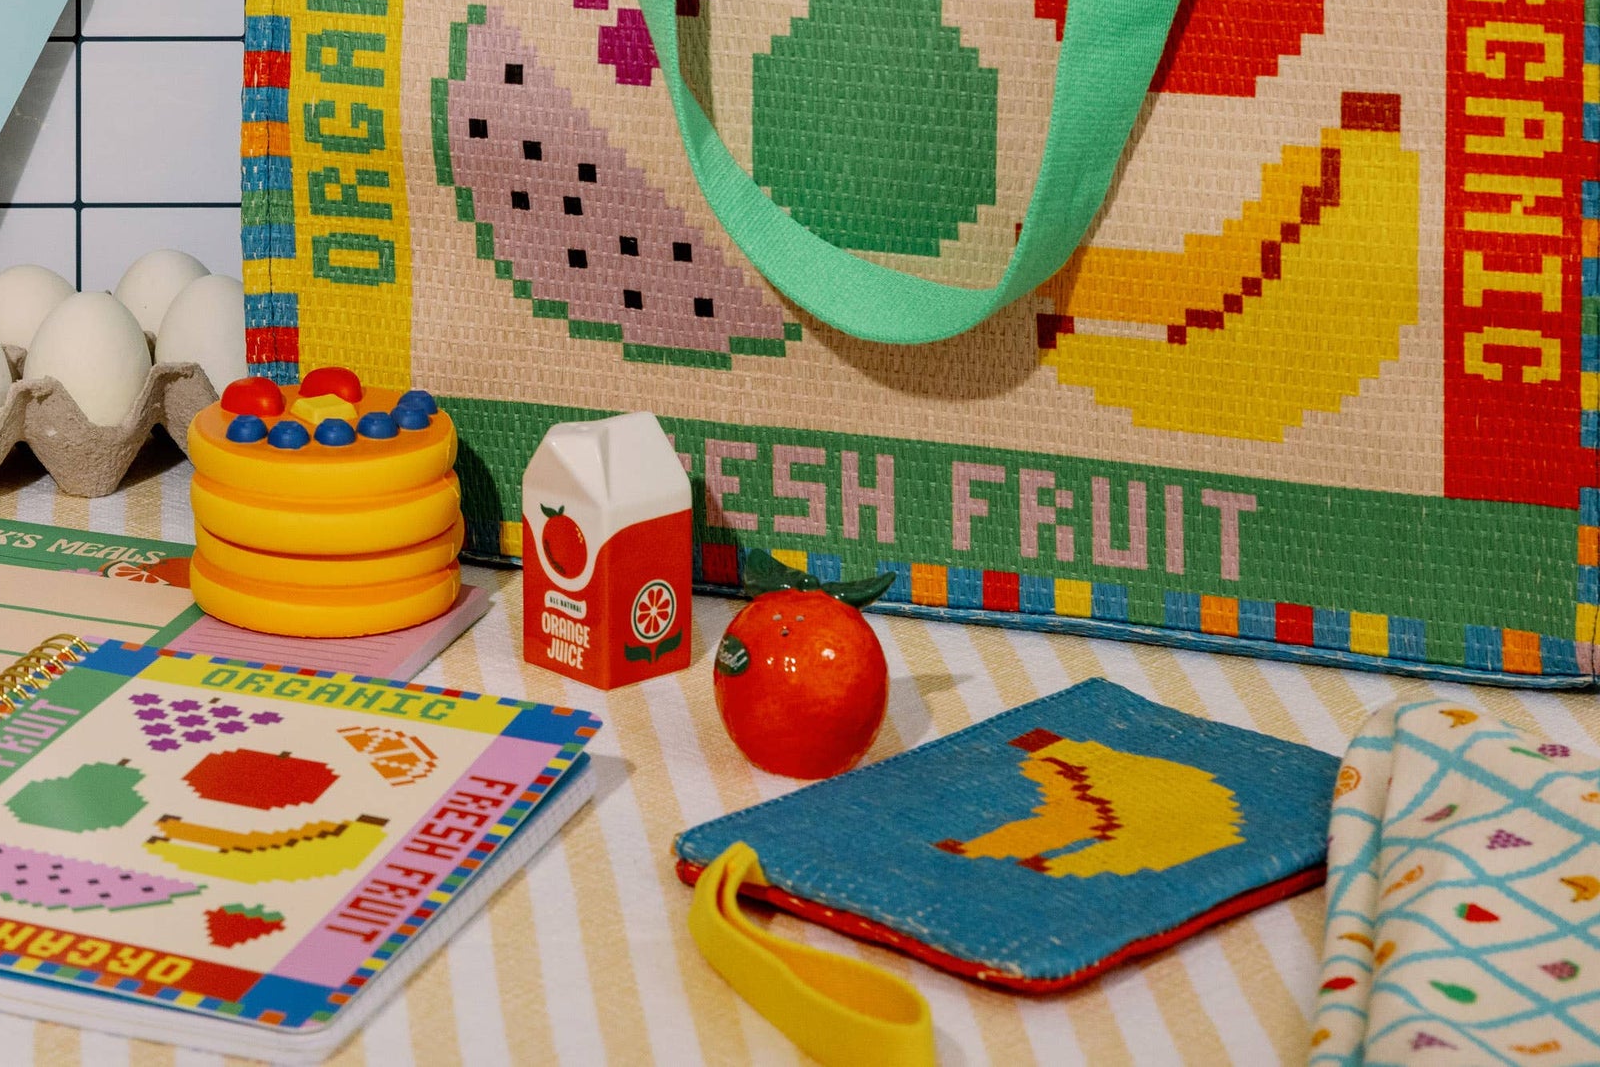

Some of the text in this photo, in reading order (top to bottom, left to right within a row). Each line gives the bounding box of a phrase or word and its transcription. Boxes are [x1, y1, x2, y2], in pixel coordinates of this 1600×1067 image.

[668, 434, 1258, 582] ESH FRUIT
[47, 538, 167, 565] MEALS
[541, 611, 591, 649] ORANGE
[547, 637, 585, 670] JUICE
[200, 668, 457, 721] ORGANIC
[325, 775, 520, 944] FRESH FRUIT
